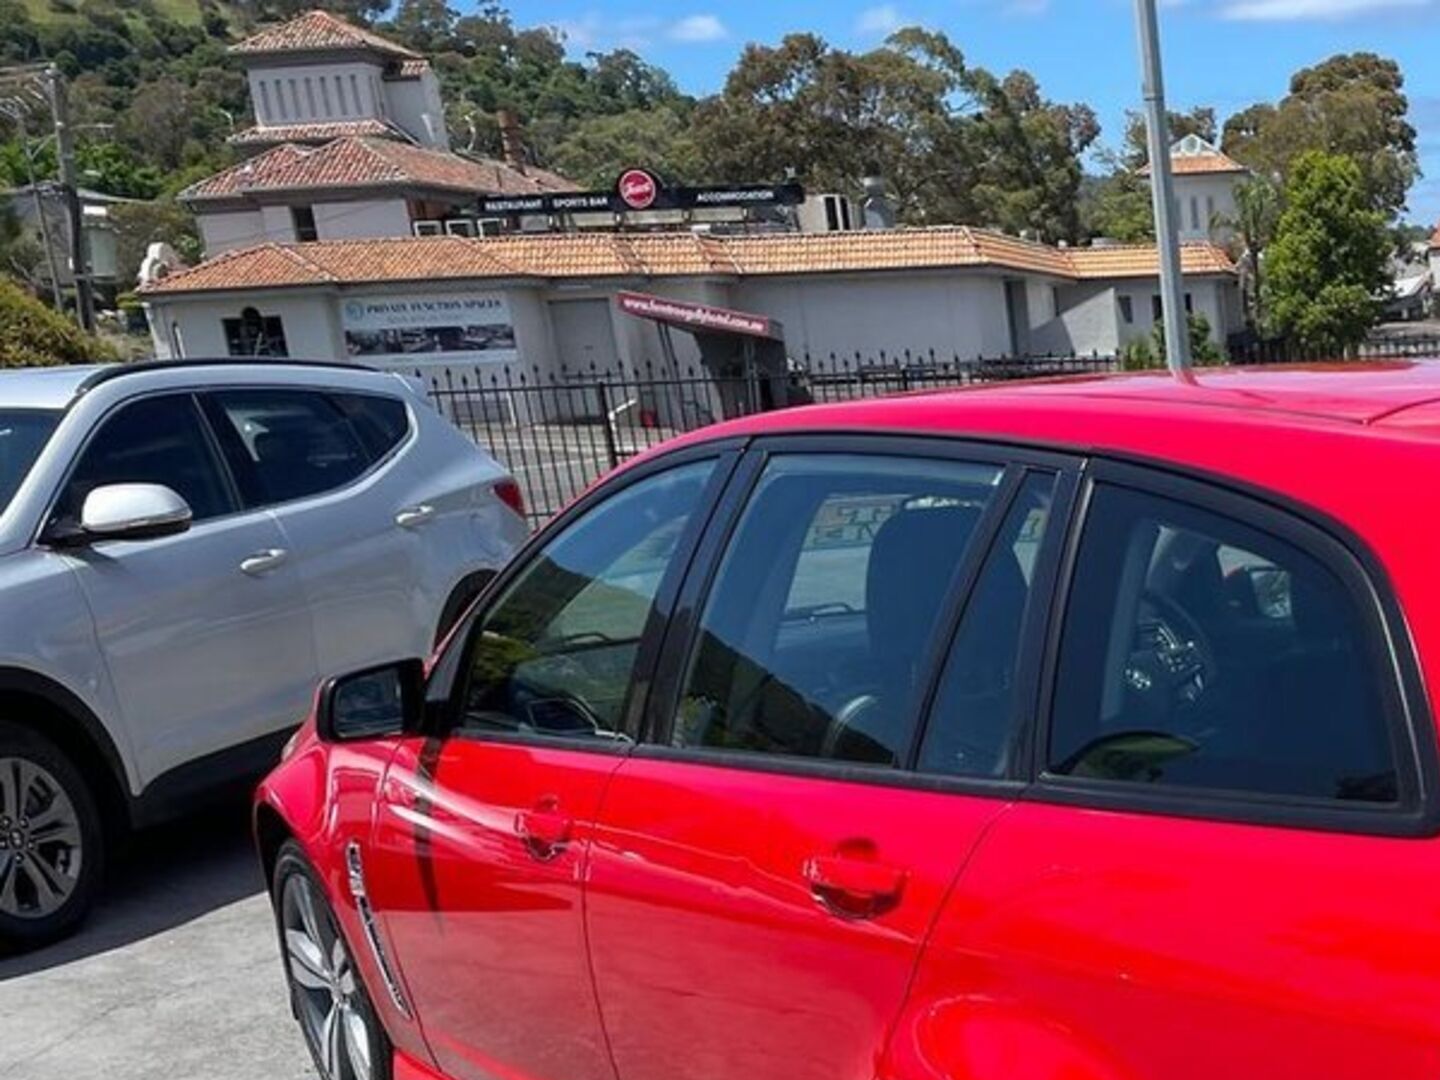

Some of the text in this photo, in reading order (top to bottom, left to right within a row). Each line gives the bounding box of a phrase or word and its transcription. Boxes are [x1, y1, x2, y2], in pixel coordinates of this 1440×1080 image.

[697, 190, 774, 202] ACCOMMODATION
[485, 199, 542, 211] RESTAURANT
[553, 197, 609, 209] SPORTS BAR
